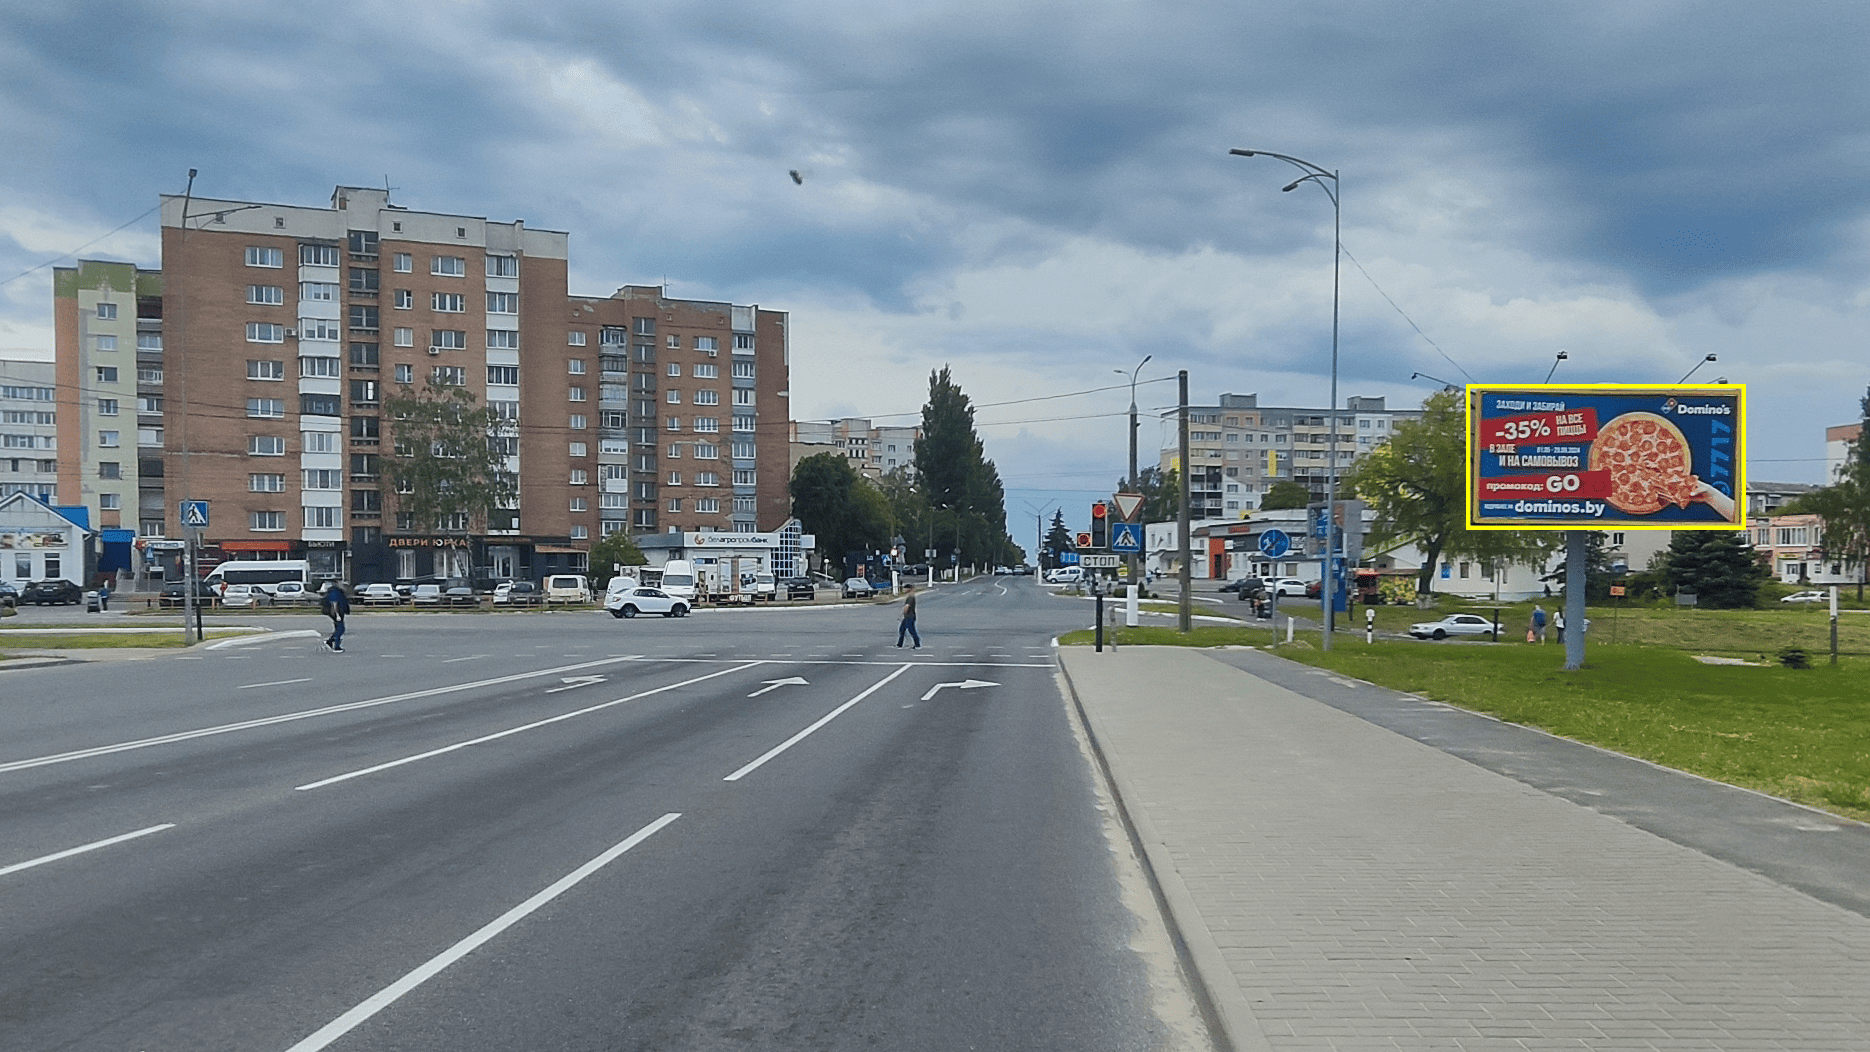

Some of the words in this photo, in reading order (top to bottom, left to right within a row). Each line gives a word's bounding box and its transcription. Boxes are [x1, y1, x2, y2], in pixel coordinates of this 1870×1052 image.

[1496, 400, 1525, 410] ЗАХОДИ
[1526, 401, 1532, 410] И
[1532, 401, 1565, 411] ЗАБИРАЙ
[1677, 404, 1731, 415] Domino's
[1556, 415, 1567, 425] НА
[1568, 413, 1583, 424] ВСЕ
[1495, 418, 1551, 440] -35%
[1556, 424, 1587, 436] ПИЦЦЫ
[1489, 444, 1495, 453] В
[1496, 444, 1516, 453] ЗАЛЕ
[1499, 455, 1506, 466] И
[1507, 455, 1520, 466] НА
[1521, 455, 1578, 467] САМОВЫВОЗ
[1486, 483, 1544, 491] промокод:
[1546, 474, 1580, 493] GO
[1514, 499, 1605, 517] dominos.by
[389, 538, 428, 548] ДВЕРИ
[1084, 556, 1115, 566] СТОП
